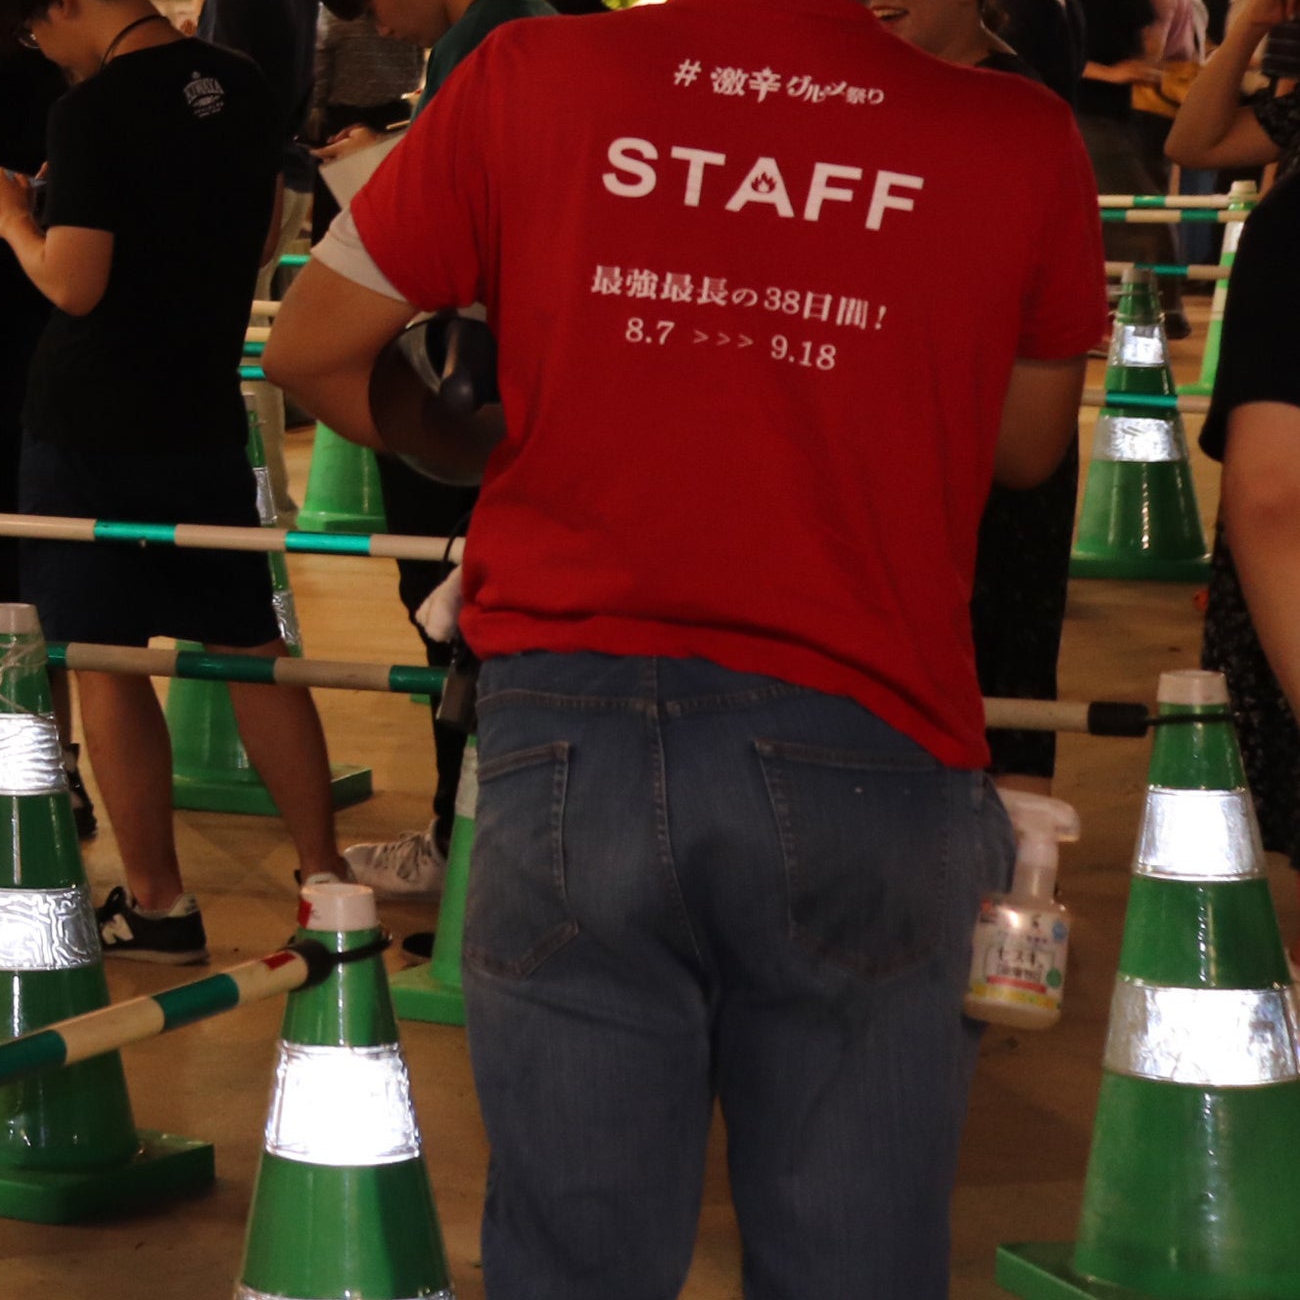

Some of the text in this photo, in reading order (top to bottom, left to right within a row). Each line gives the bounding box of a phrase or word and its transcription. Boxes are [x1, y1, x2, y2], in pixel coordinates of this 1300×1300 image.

[710, 65, 884, 105] 激辛グルメ祭り
[602, 136, 925, 232] STAFF
[591, 264, 888, 331] 最強最長の38日間!
[625, 317, 676, 346] 8.7
[770, 335, 837, 371] 9.18
